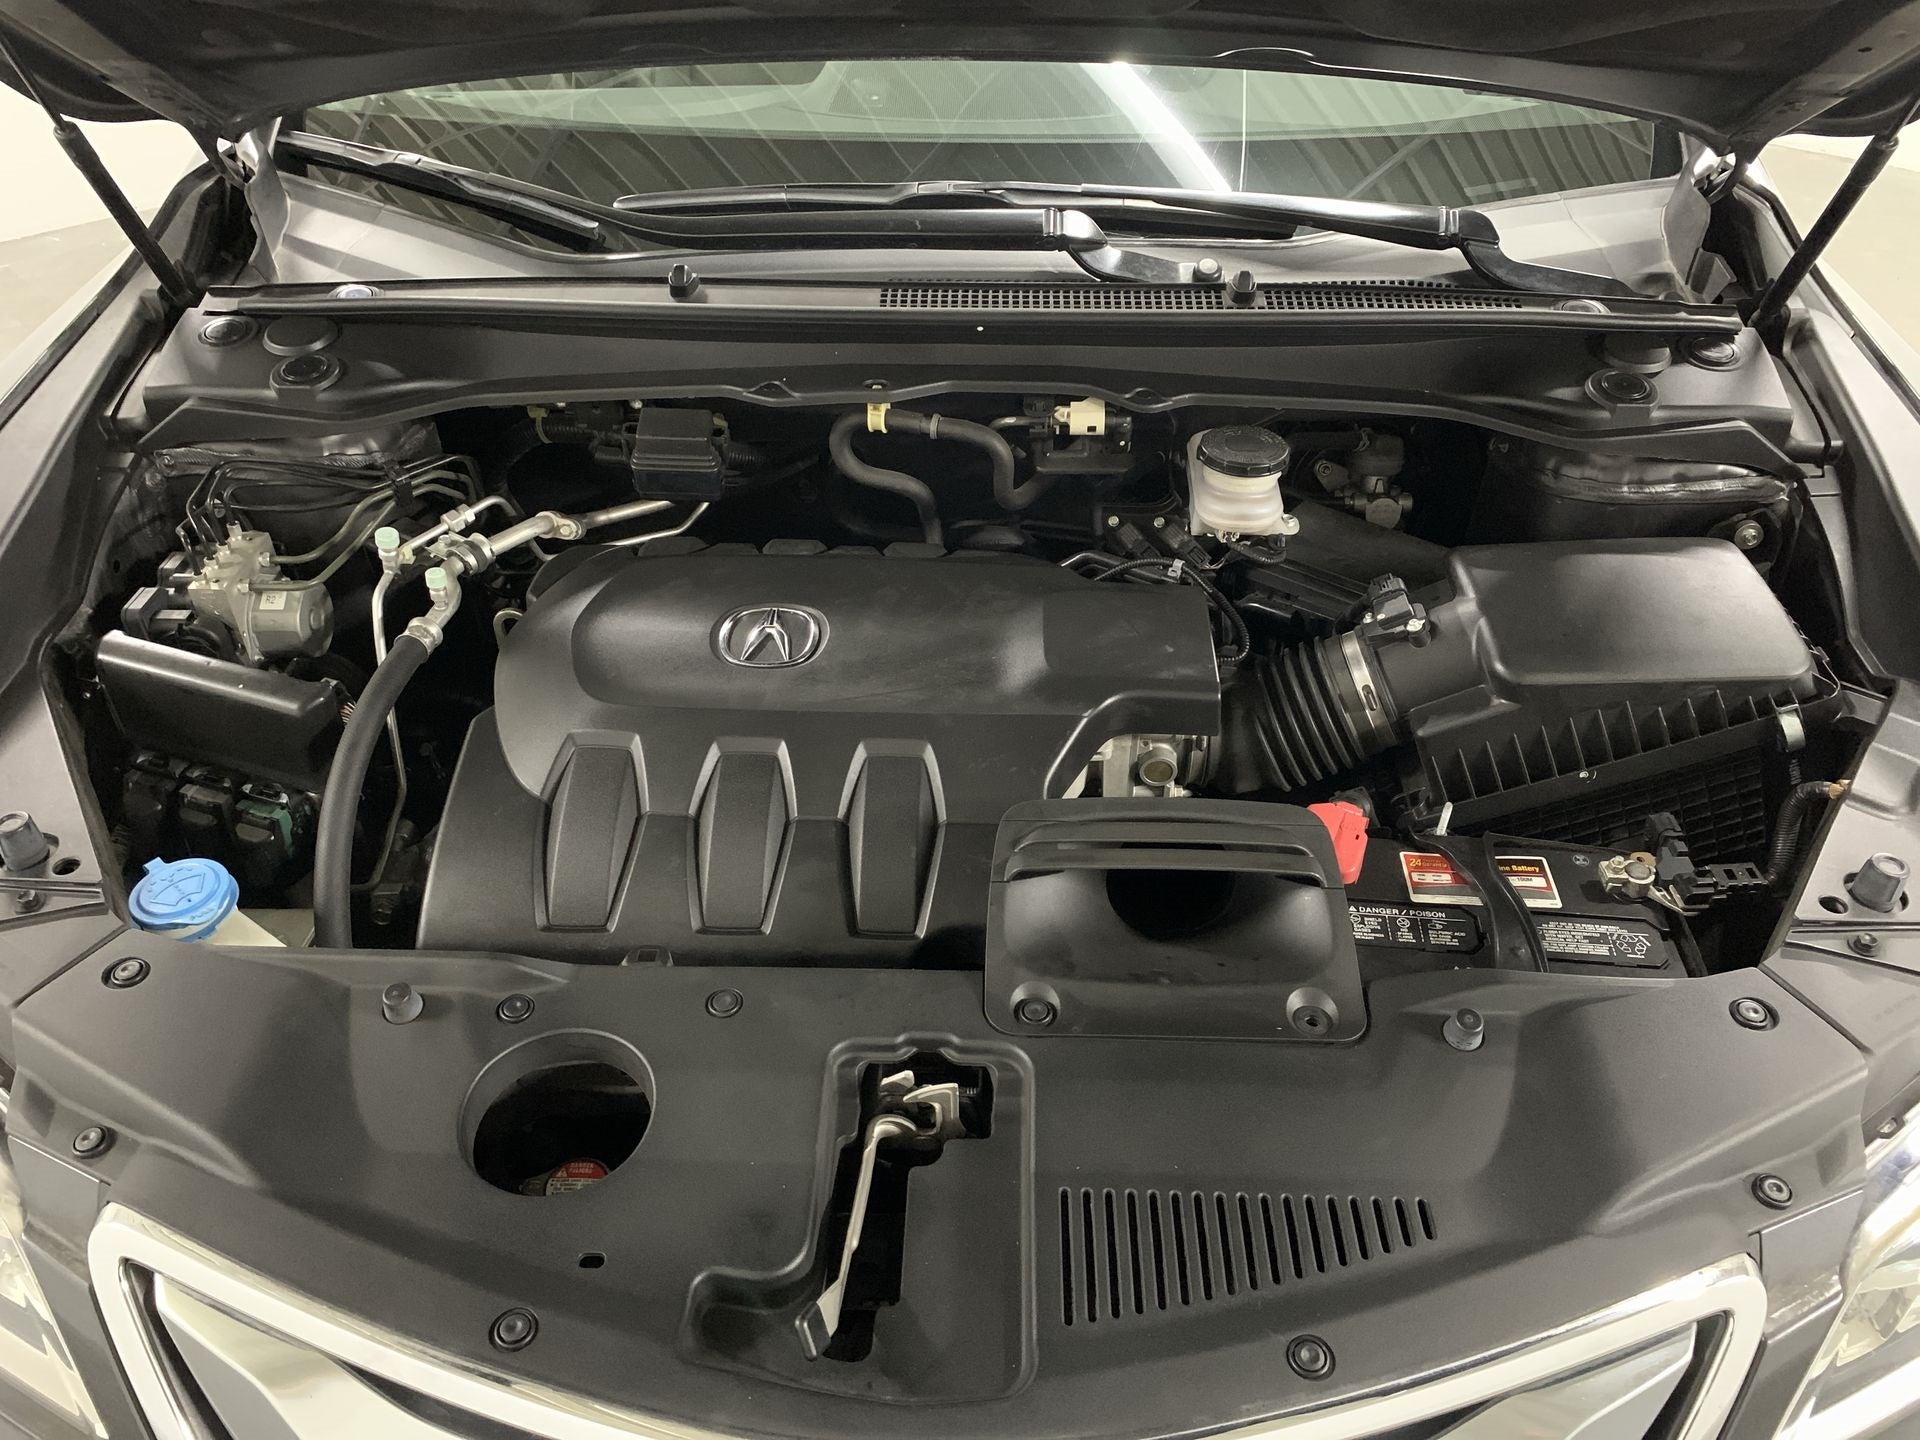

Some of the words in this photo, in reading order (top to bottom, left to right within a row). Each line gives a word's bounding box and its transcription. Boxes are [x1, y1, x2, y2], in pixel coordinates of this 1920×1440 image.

[1409, 858, 1422, 867] 24
[1511, 865, 1539, 873] Battery
[1359, 906, 1399, 915] DANGER
[1409, 909, 1446, 918] POISON
